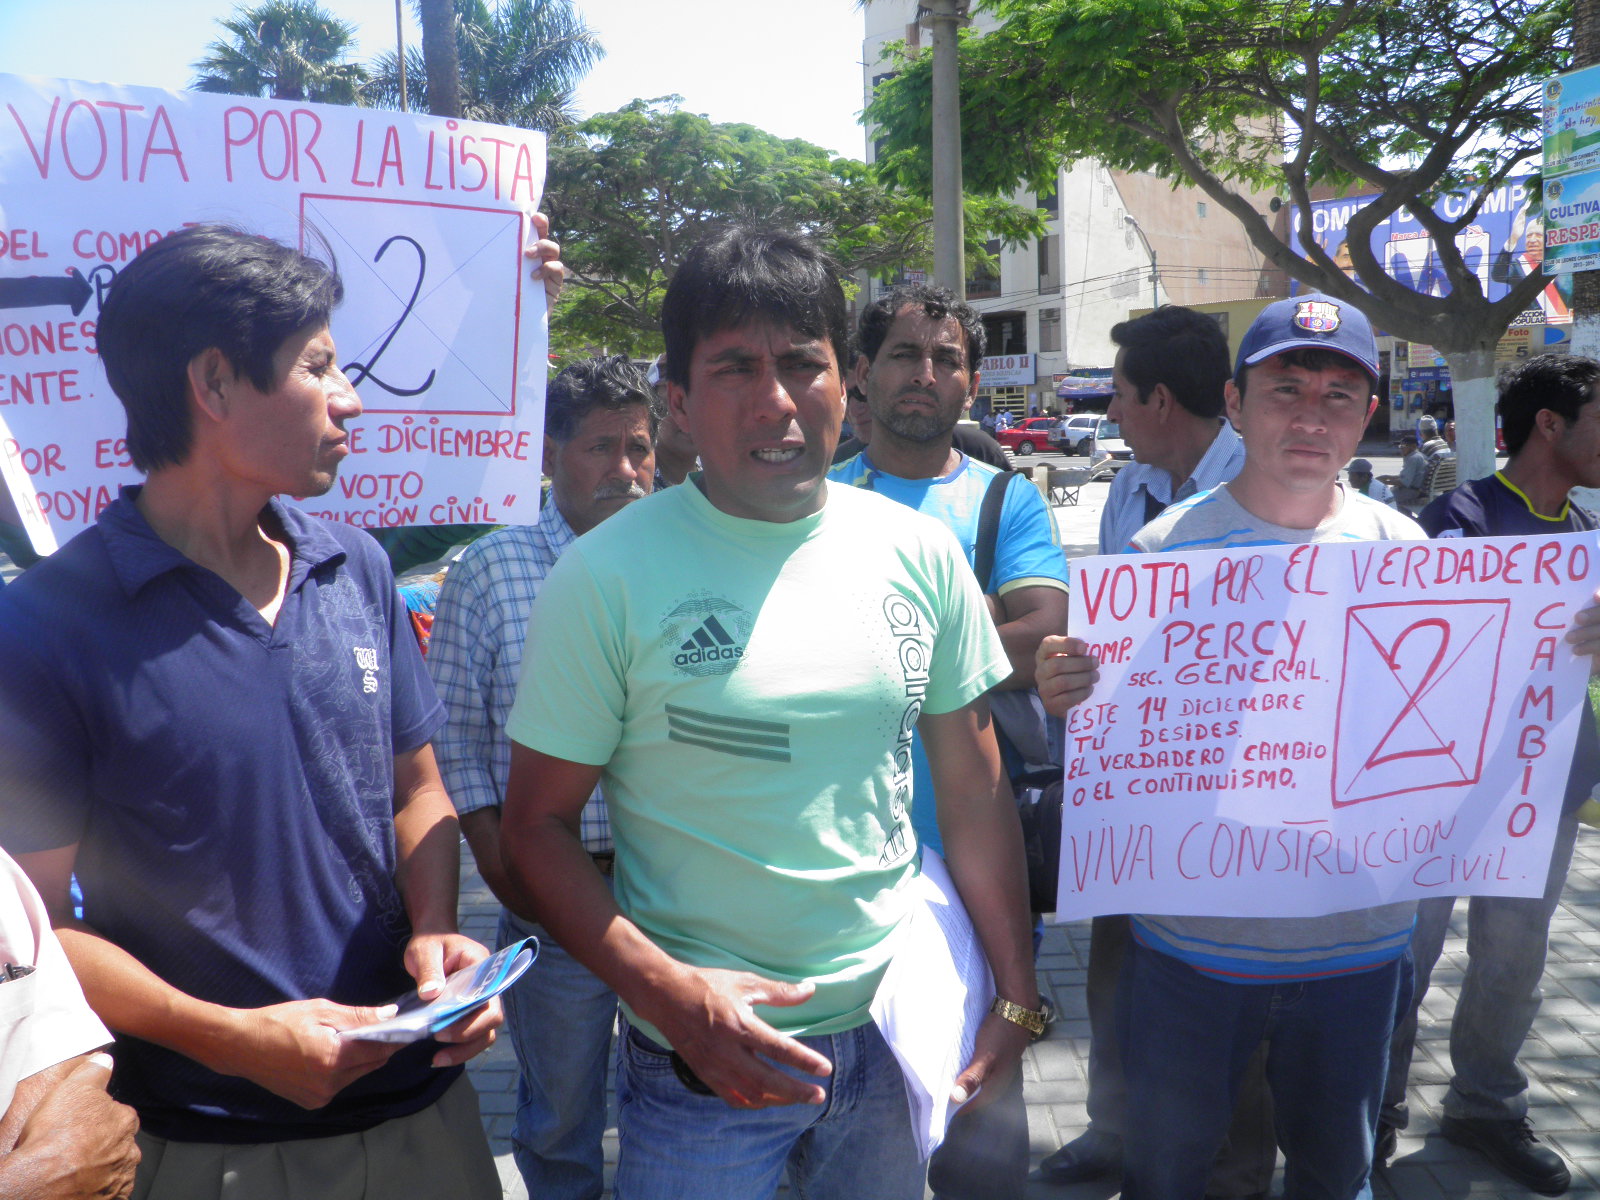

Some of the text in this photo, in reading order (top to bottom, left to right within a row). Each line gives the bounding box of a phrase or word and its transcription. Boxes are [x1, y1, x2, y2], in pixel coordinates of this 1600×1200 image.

[7, 96, 535, 202] VOTA POR LA LISTA
[1547, 222, 1600, 247] RESPE
[342, 235, 436, 397] 2
[1508, 328, 1529, 337] Foto
[981, 356, 1015, 371] ABLO
[1516, 345, 1528, 358] 5
[345, 416, 532, 461] E DICIEMBRE
[339, 470, 424, 500] VOTO
[1079, 540, 1590, 627] VOTA POR EL VERDADERO
[674, 645, 744, 666] adidas
[1086, 618, 1306, 671] OMP. PERCY
[1174, 656, 1329, 687] GENERAL.
[1067, 693, 1307, 735] ESTE 14 DICIEMBRE
[1363, 616, 1458, 771] 2
[1074, 719, 1243, 756] TÚ DESIDES.
[1506, 600, 1567, 840] CAMBIO
[1067, 740, 1328, 782] EL VERDADERO CAMBIO
[1072, 767, 1298, 807] O EL CONTINUISMO.
[1070, 818, 1156, 893] VIVA
[1412, 844, 1528, 888] CIVIL.
